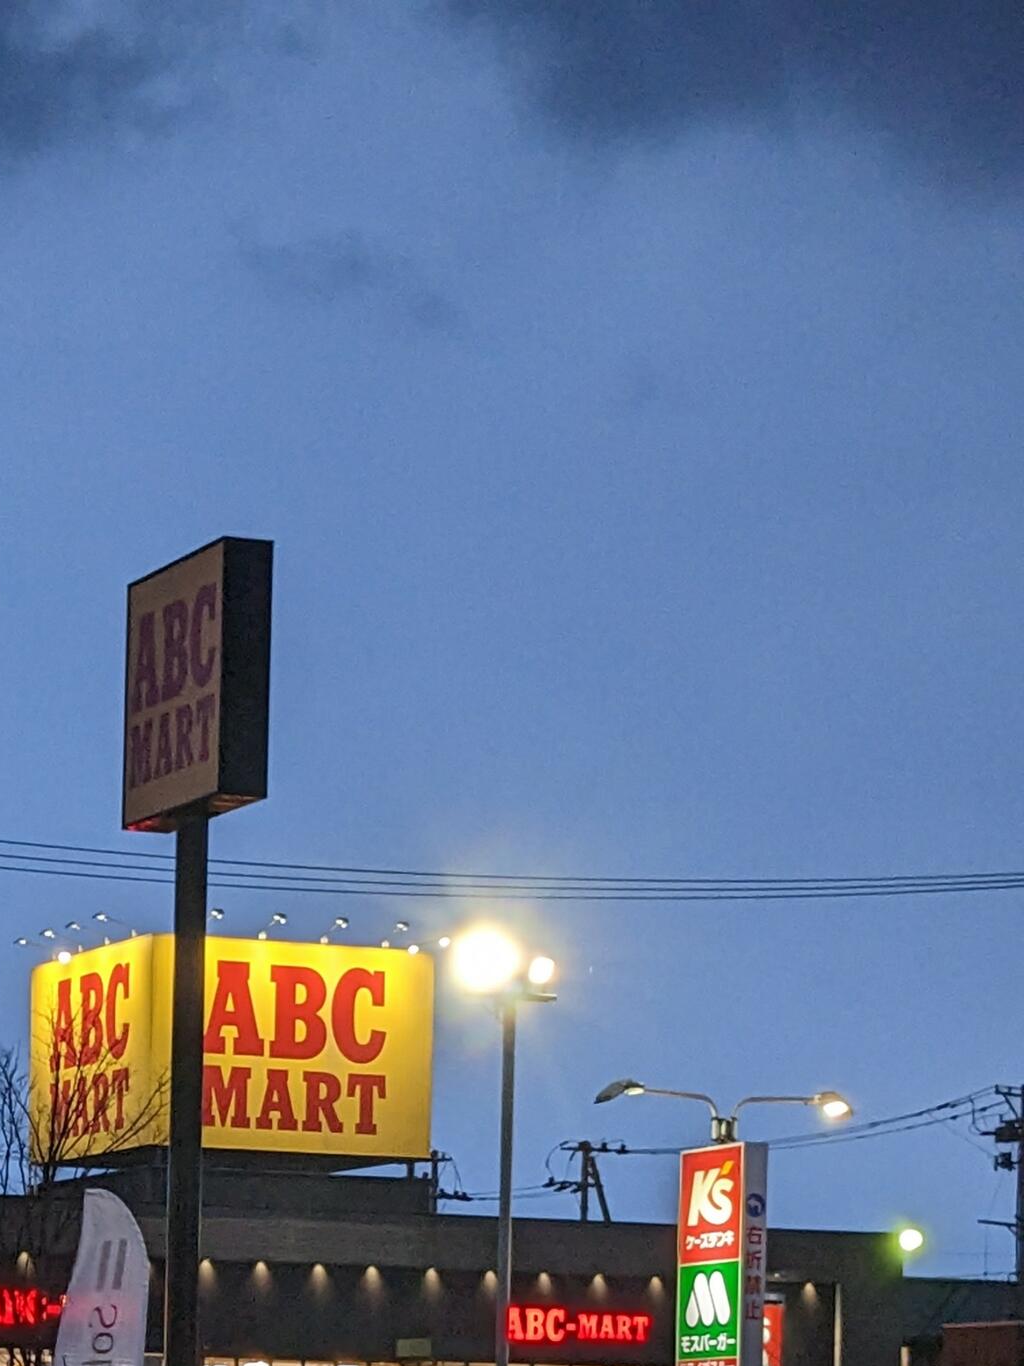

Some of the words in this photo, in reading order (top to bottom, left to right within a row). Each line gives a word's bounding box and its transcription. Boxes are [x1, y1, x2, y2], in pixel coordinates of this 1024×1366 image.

[131, 582, 217, 714] ABC
[130, 693, 215, 790] MART
[50, 963, 130, 1072] ABC
[204, 960, 386, 1064] ABC
[203, 1065, 386, 1135] MART
[508, 1307, 649, 1342] ABC-MART
[681, 1332, 736, 1353] モスバーガー
